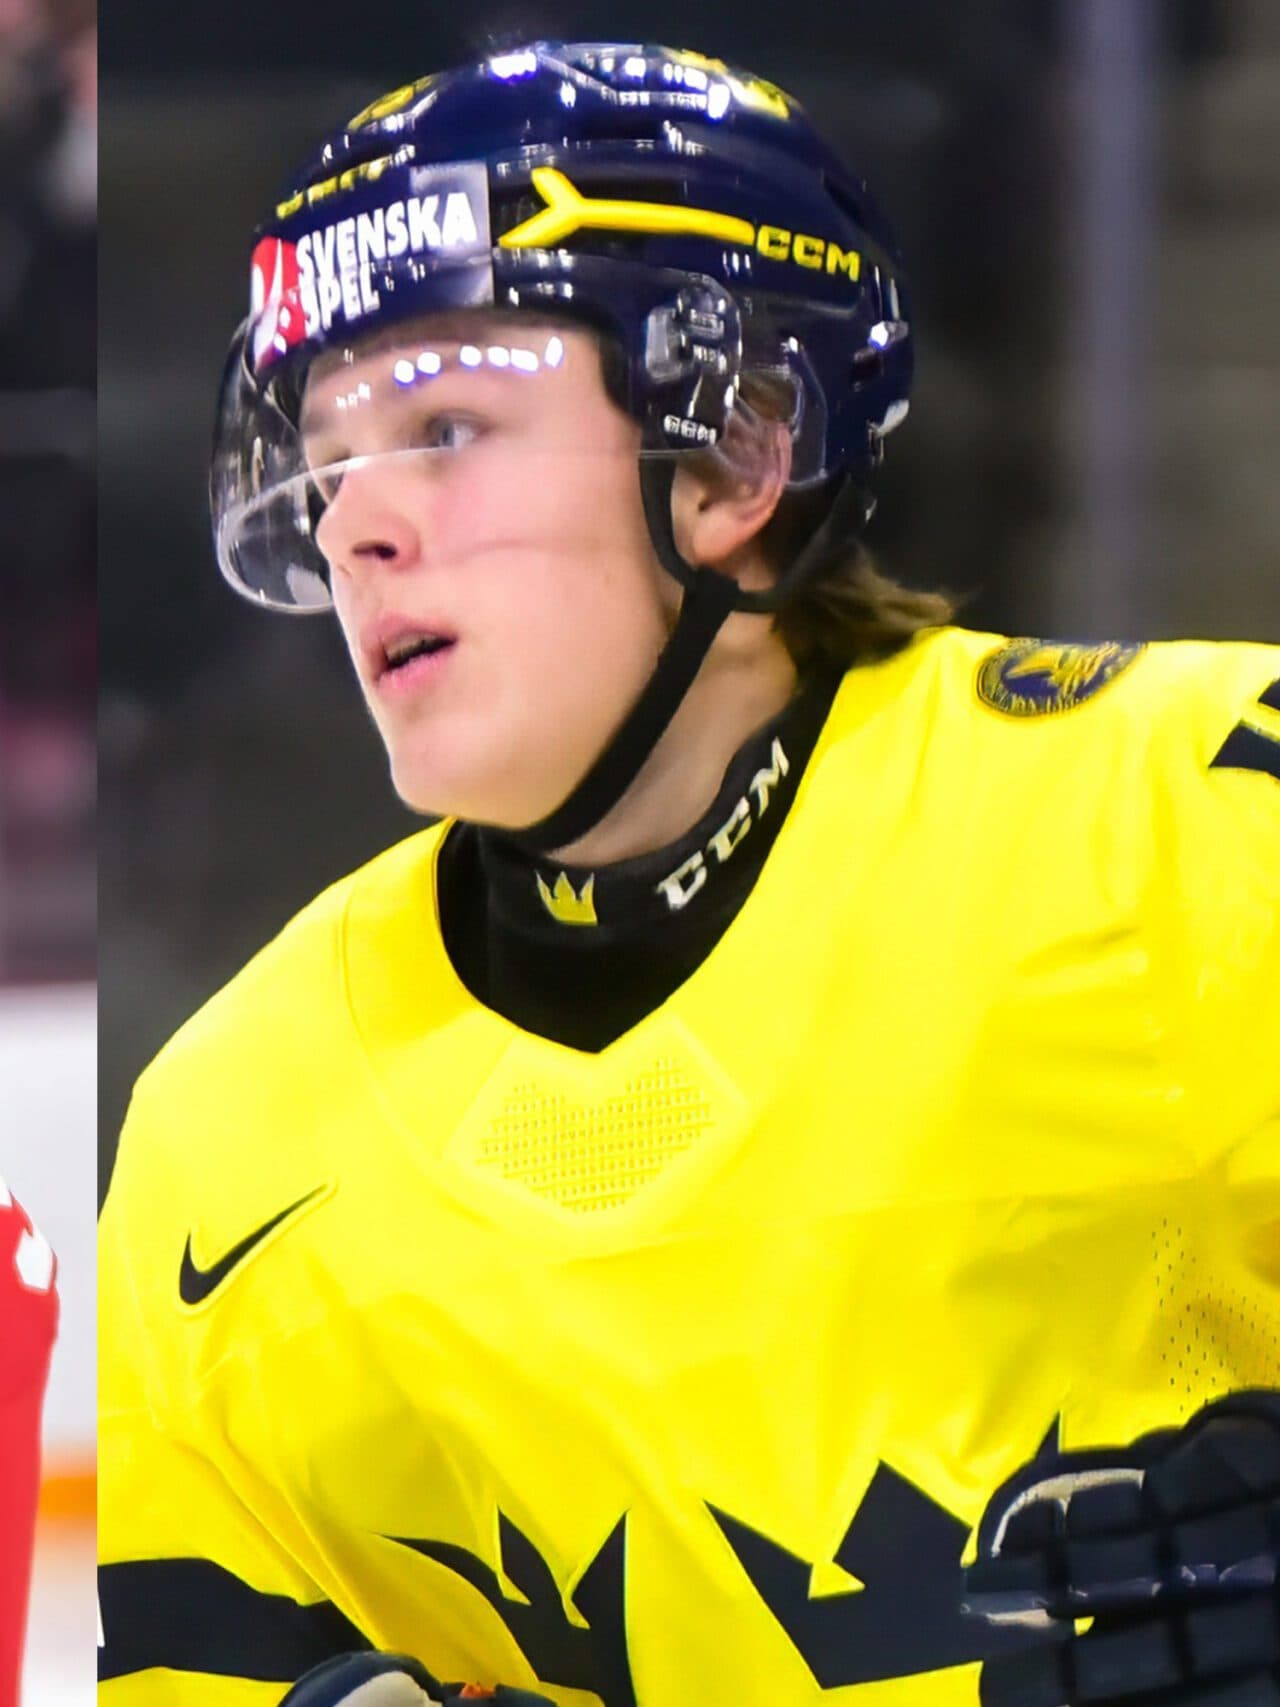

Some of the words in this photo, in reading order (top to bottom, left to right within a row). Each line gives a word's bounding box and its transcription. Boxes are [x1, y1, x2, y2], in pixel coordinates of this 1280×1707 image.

[296, 193, 478, 275] SVENSKA
[757, 225, 860, 282] CCM
[298, 262, 381, 338] SPEL
[655, 736, 790, 910] CCM
